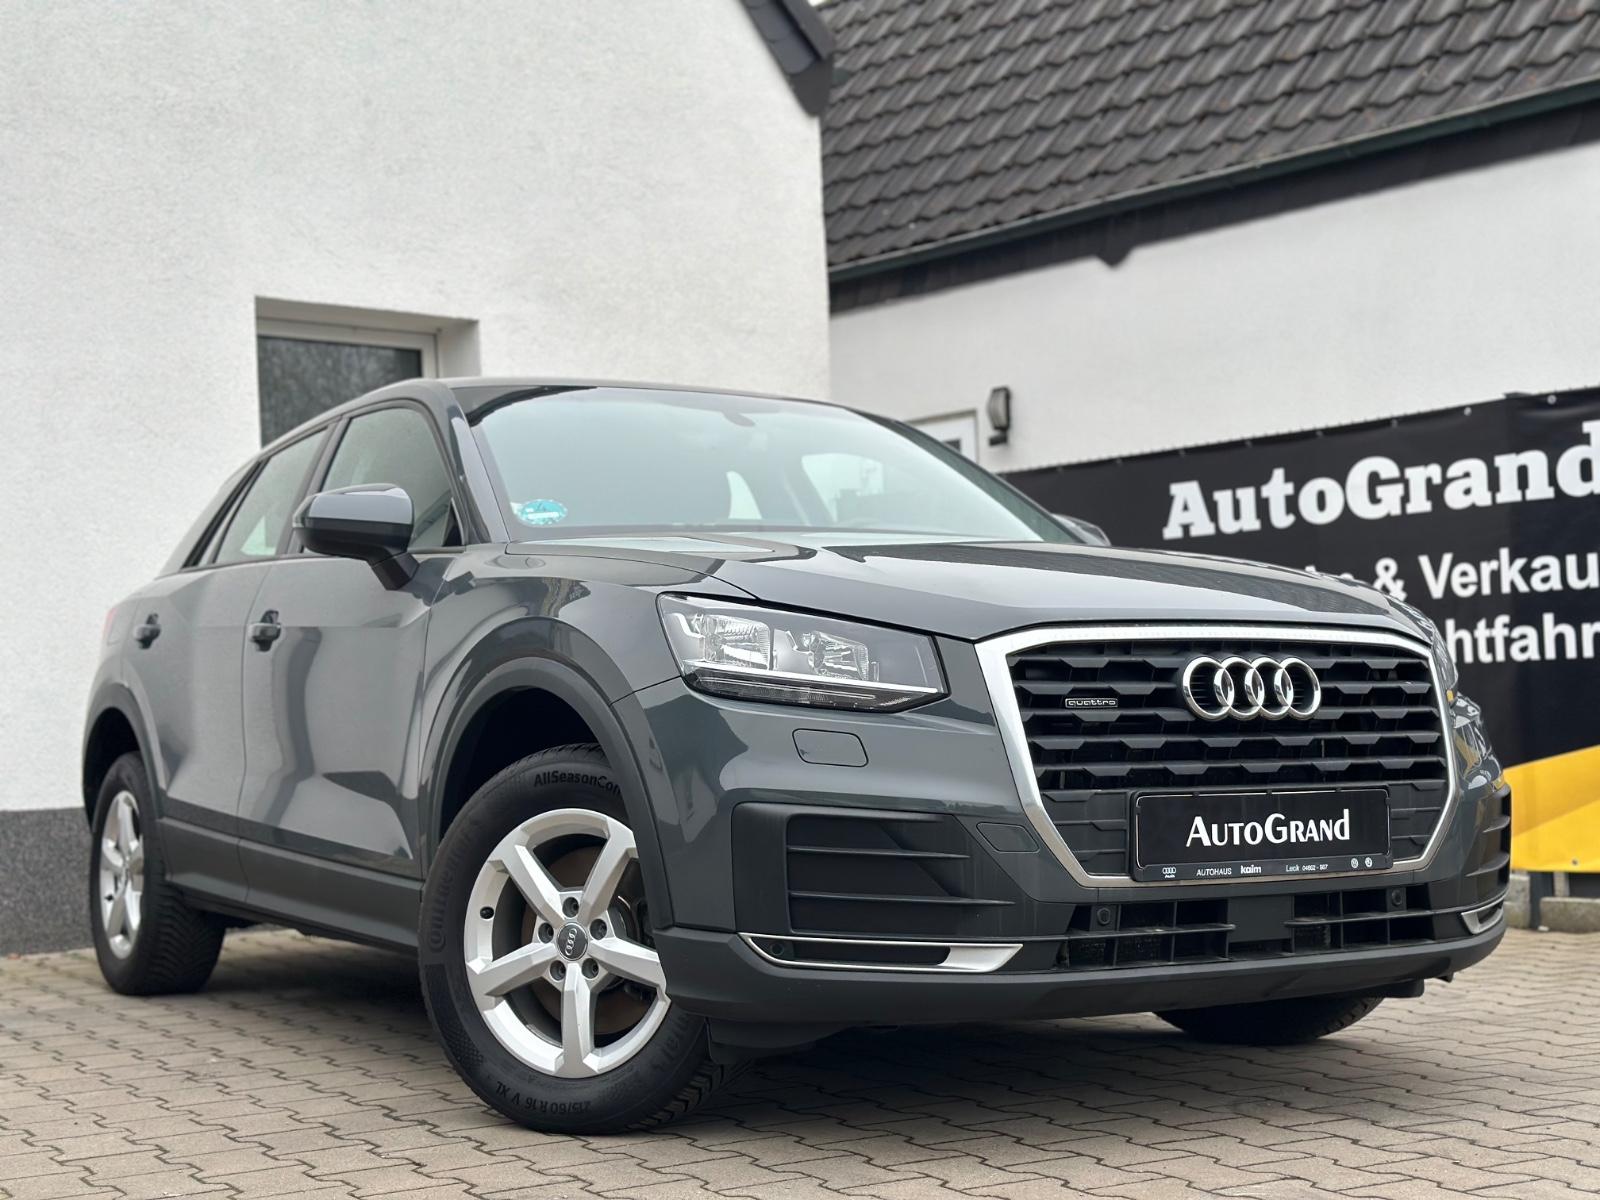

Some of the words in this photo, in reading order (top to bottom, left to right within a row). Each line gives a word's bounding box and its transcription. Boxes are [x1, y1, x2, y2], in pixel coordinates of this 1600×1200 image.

[1162, 420, 1600, 541] AutoGrand
[1373, 557, 1408, 601] &
[1417, 547, 1600, 600] Verkau
[1444, 612, 1600, 664] htfahr
[1068, 699, 1116, 707] quattro
[1196, 867, 1232, 877] AUTOHAUS
[1240, 864, 1262, 874] kaim
[496, 1081, 511, 1098] XL
[511, 1092, 520, 1104] V
[525, 1097, 537, 1110] 16
[539, 1100, 548, 1112] R
